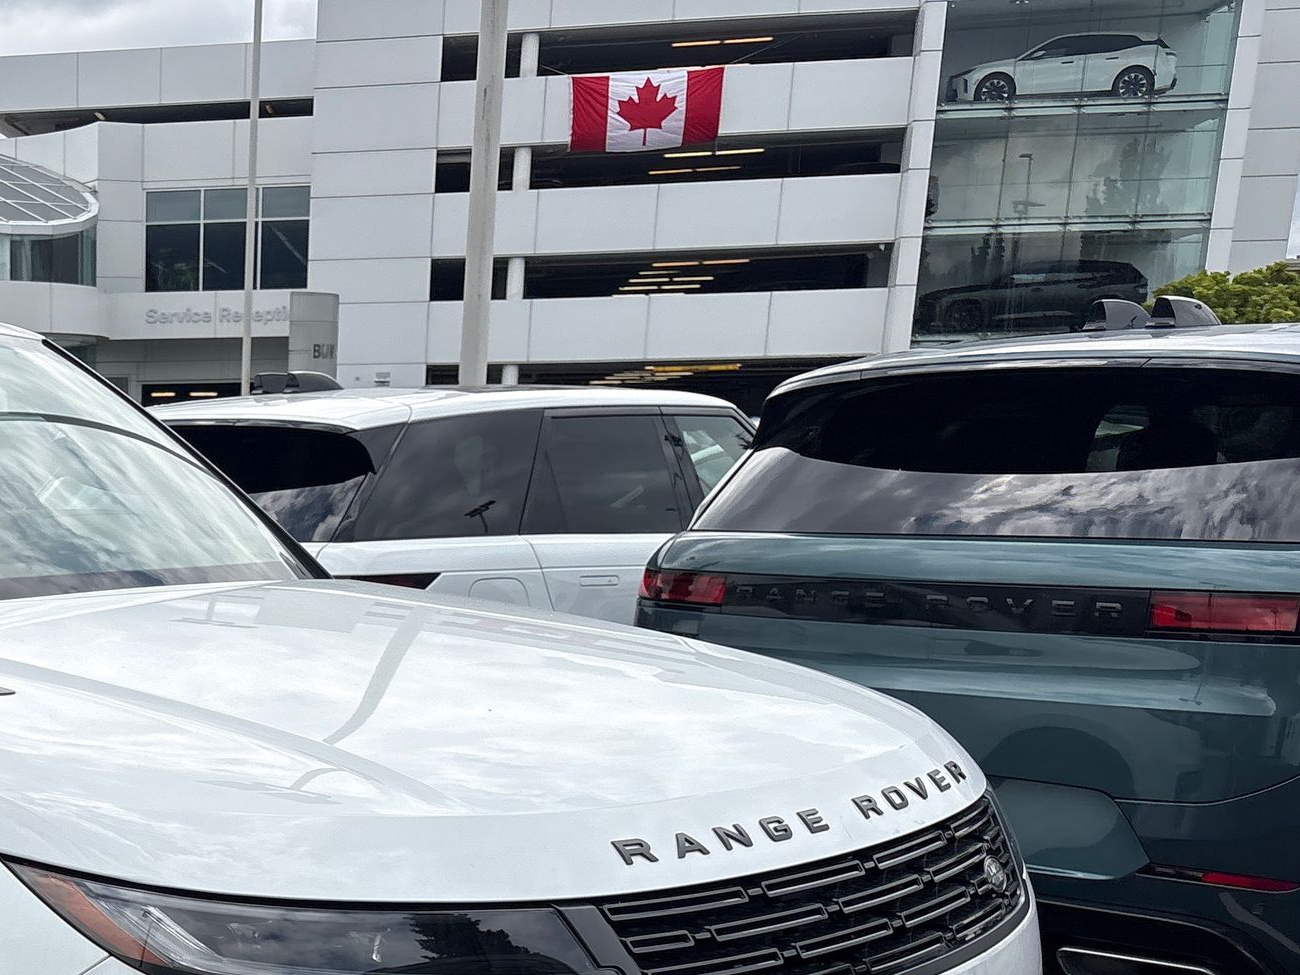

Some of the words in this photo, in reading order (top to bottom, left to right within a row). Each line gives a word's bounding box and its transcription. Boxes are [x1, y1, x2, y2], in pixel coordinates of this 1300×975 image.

[144, 307, 213, 325] Service
[218, 305, 289, 326] Reepti
[610, 807, 830, 865] RANGE
[851, 760, 967, 819] ROVER
